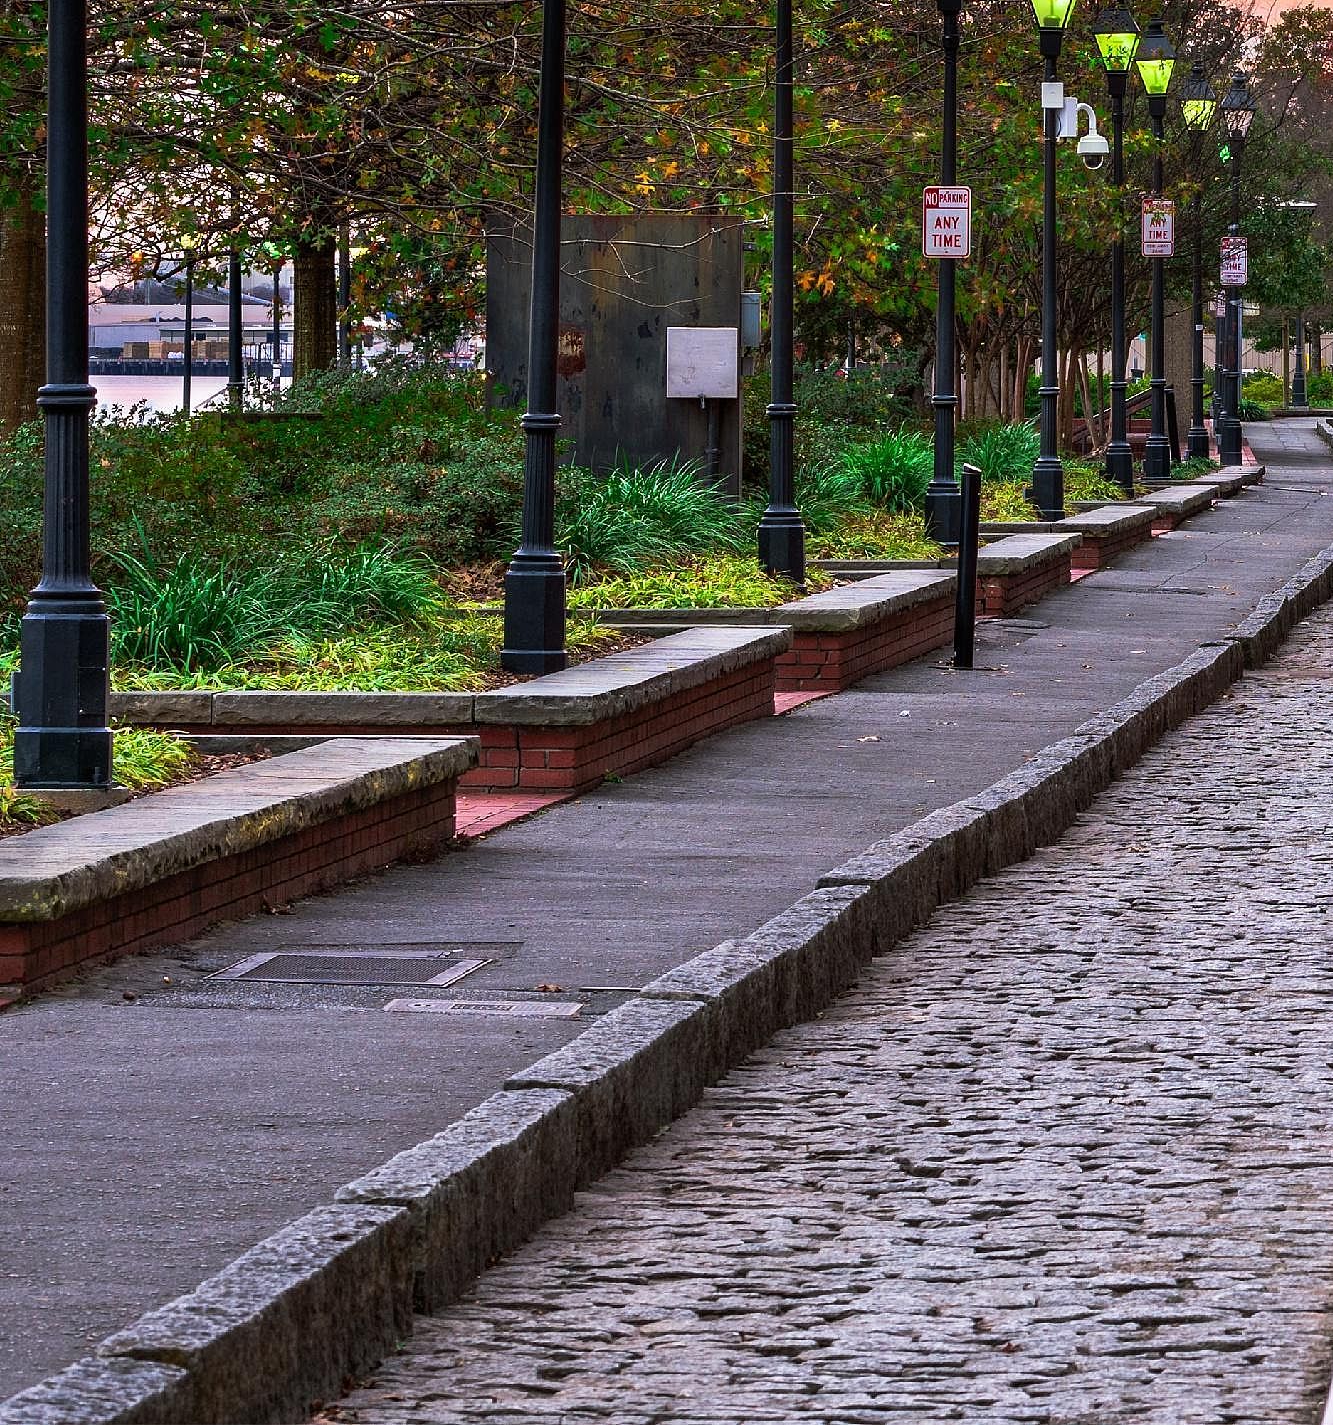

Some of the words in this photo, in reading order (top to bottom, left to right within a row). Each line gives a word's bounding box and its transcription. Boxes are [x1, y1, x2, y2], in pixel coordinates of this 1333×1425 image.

[926, 192, 938, 205] NO
[940, 193, 968, 203] PARKING
[934, 216, 960, 229] ANY
[931, 234, 961, 247] TIME
[1149, 231, 1169, 240] TIME
